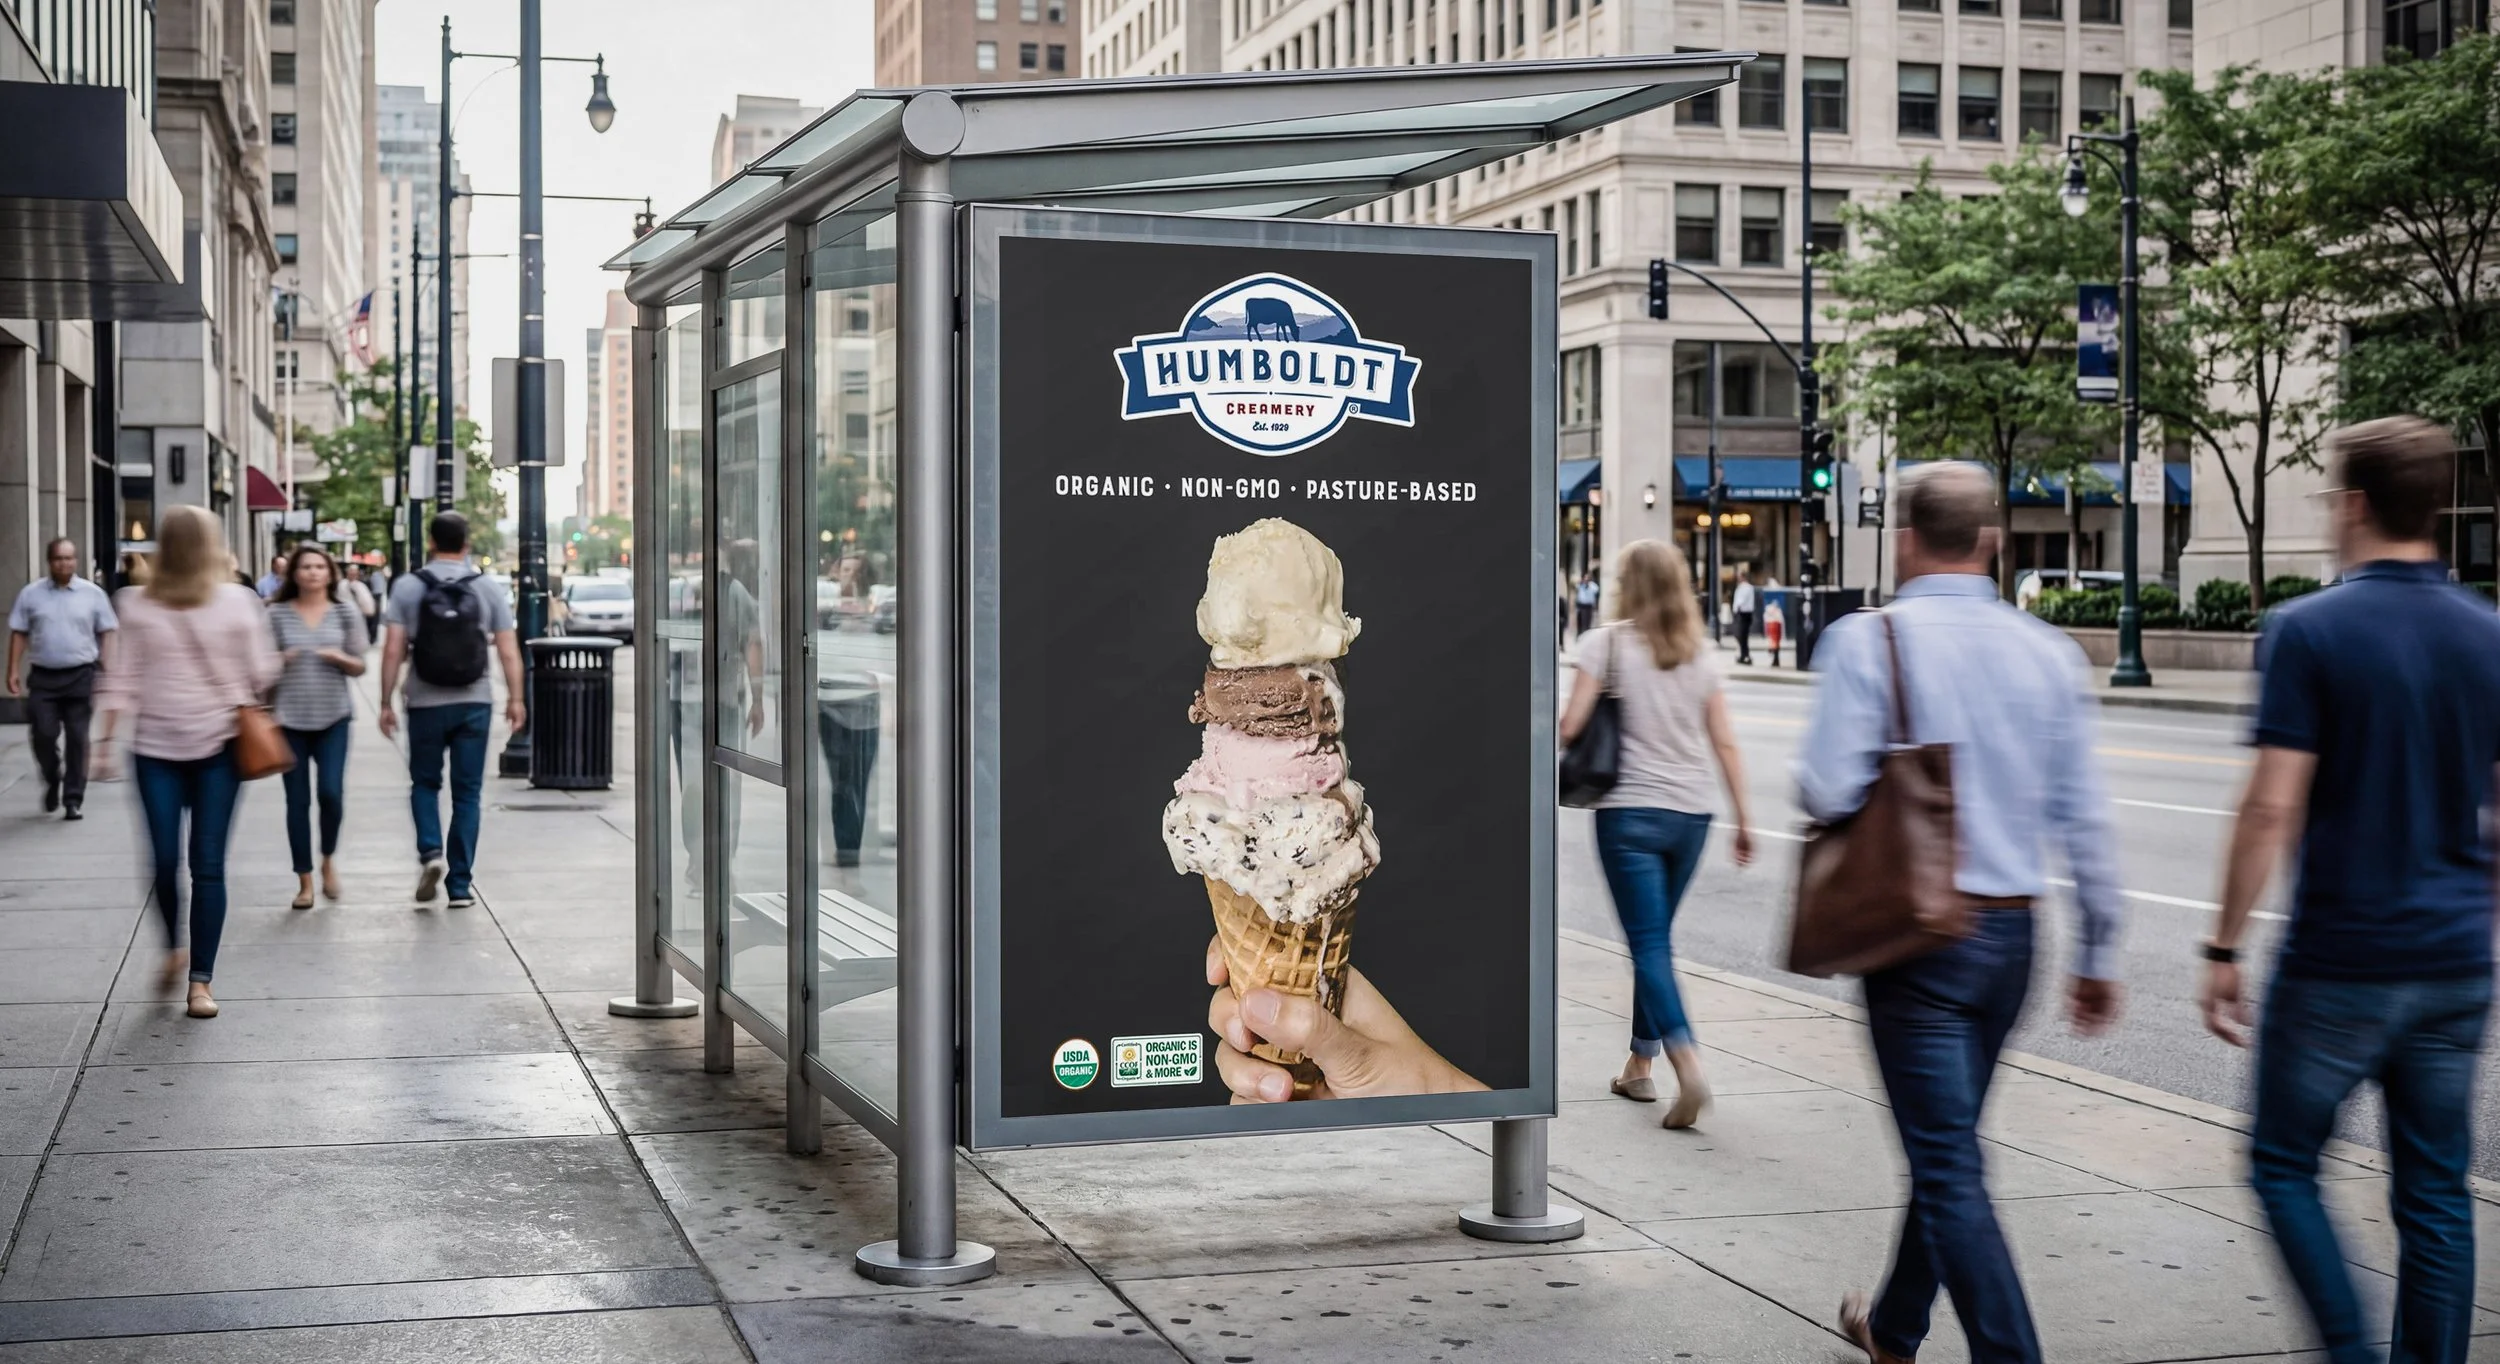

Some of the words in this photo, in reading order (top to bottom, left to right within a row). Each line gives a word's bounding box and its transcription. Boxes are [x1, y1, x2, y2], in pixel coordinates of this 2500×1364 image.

[1156, 348, 1384, 392] HUMBOLDT
[1226, 402, 1315, 417] CREAMERY
[1252, 421, 1269, 432] Est.
[1270, 423, 1290, 432] 1929
[1055, 474, 1155, 497] ORGANIC
[1181, 477, 1281, 499] NON-GMO
[1306, 479, 1478, 503] PASTURE-BASED
[1145, 1040, 1187, 1052] ORGANIC
[1188, 1039, 1198, 1051] IS
[1062, 1050, 1090, 1063] USDA
[1145, 1052, 1198, 1067] NON-GMO
[1059, 1065, 1094, 1077] ORGANIC
[1145, 1069, 1154, 1079] &
[1154, 1066, 1182, 1078] MORE
